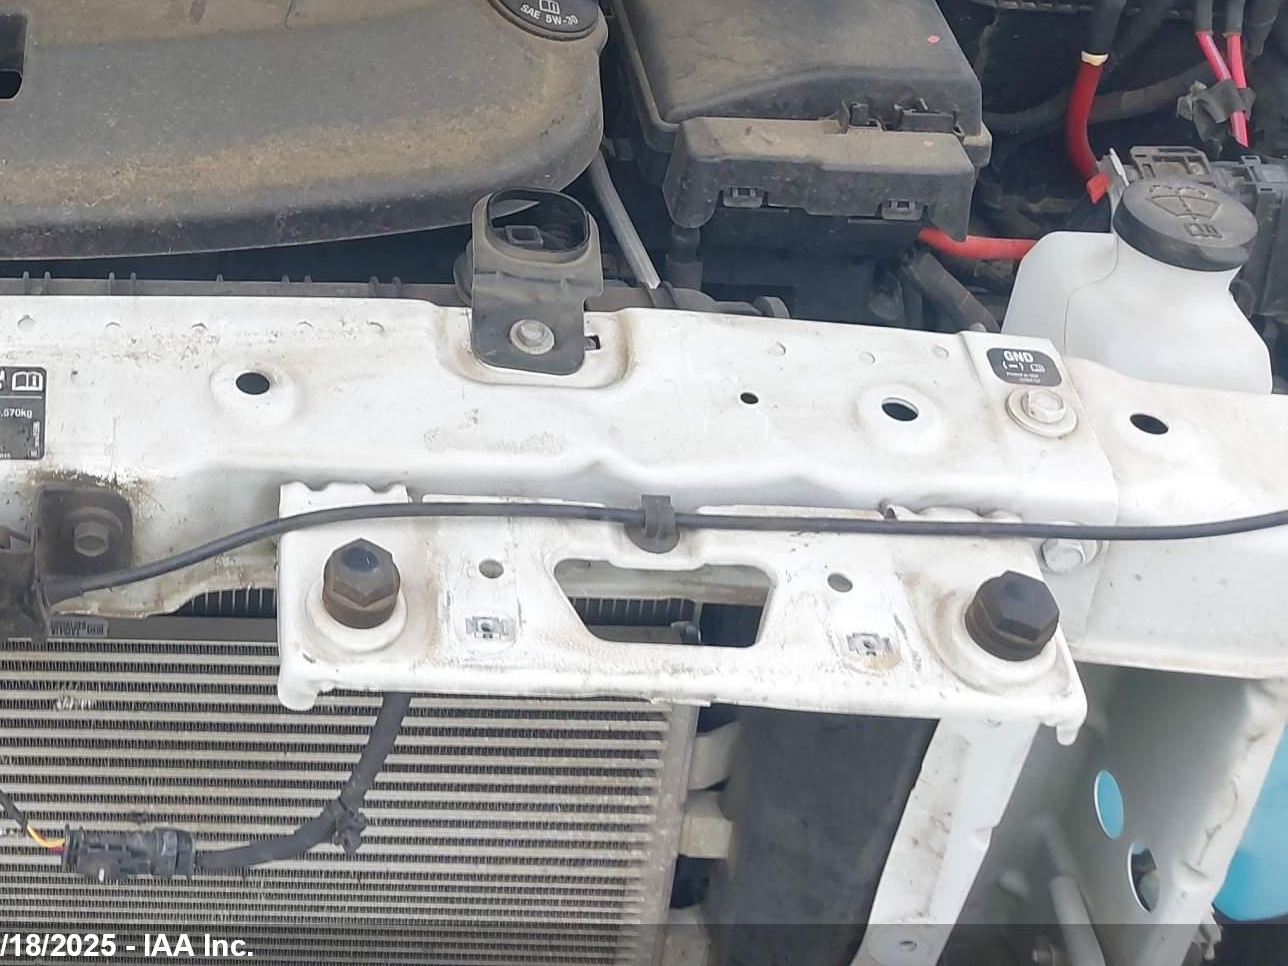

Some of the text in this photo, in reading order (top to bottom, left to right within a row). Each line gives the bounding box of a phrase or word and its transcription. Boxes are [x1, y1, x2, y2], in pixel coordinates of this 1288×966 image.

[520, 4, 579, 26] SAE 5W-30
[1003, 350, 1034, 363] GND
